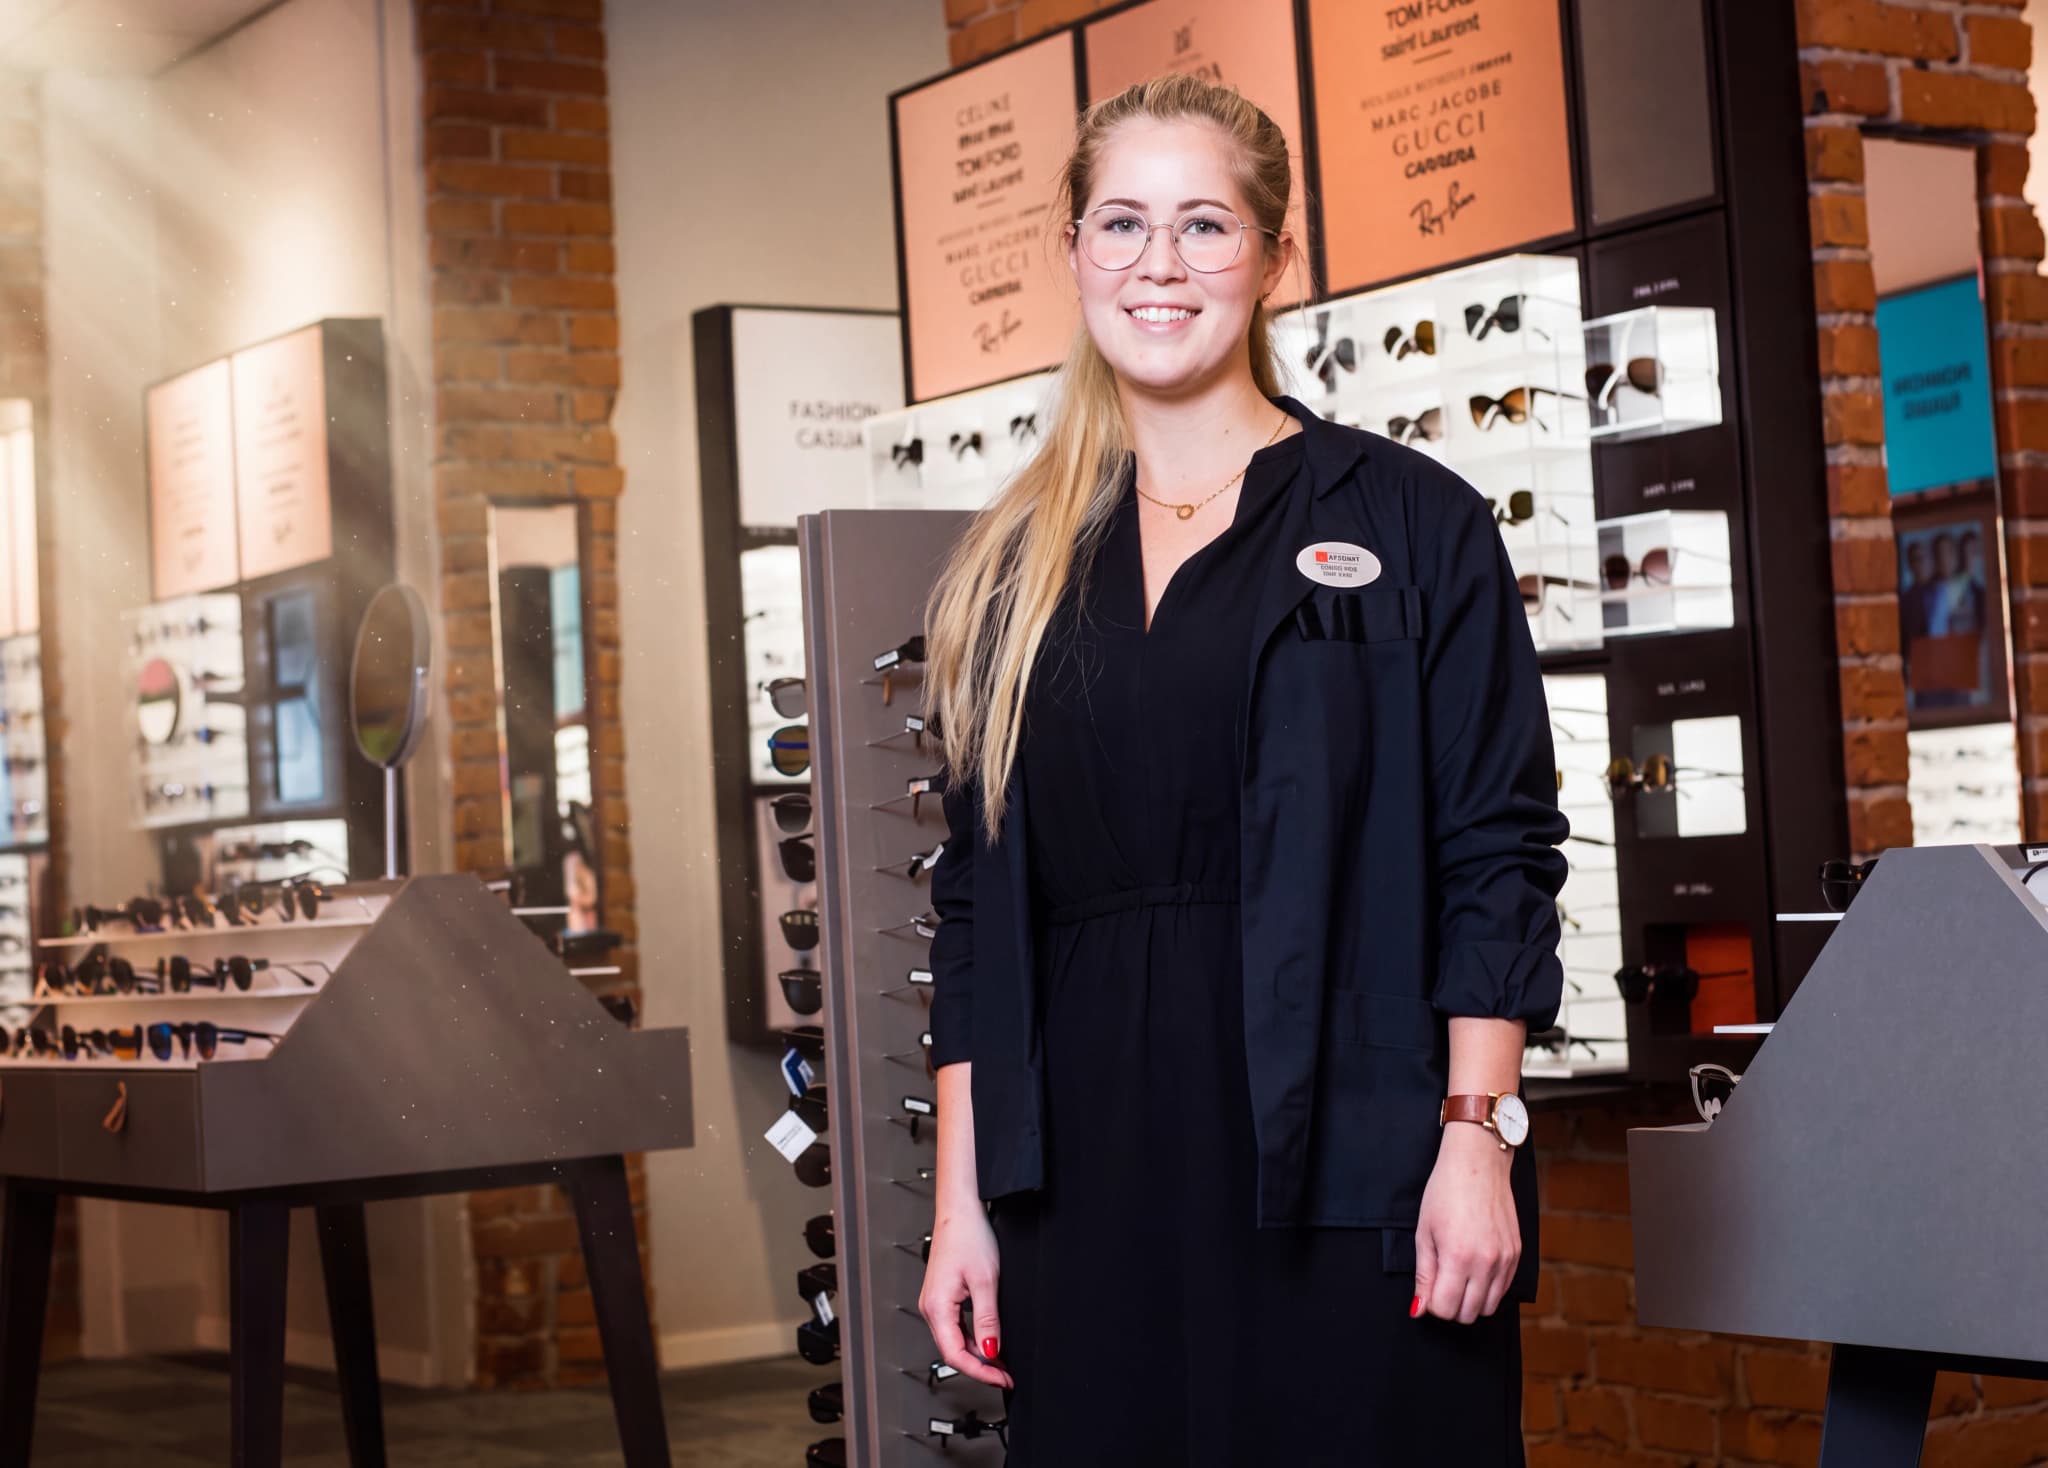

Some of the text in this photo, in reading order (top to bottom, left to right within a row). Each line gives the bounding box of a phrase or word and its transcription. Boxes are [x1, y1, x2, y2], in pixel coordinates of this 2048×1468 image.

[1385, 0, 1474, 30] TOM FO
[1372, 104, 1420, 131] MARC
[1392, 109, 1484, 157] GUCCI
[796, 428, 864, 449] CASUA
